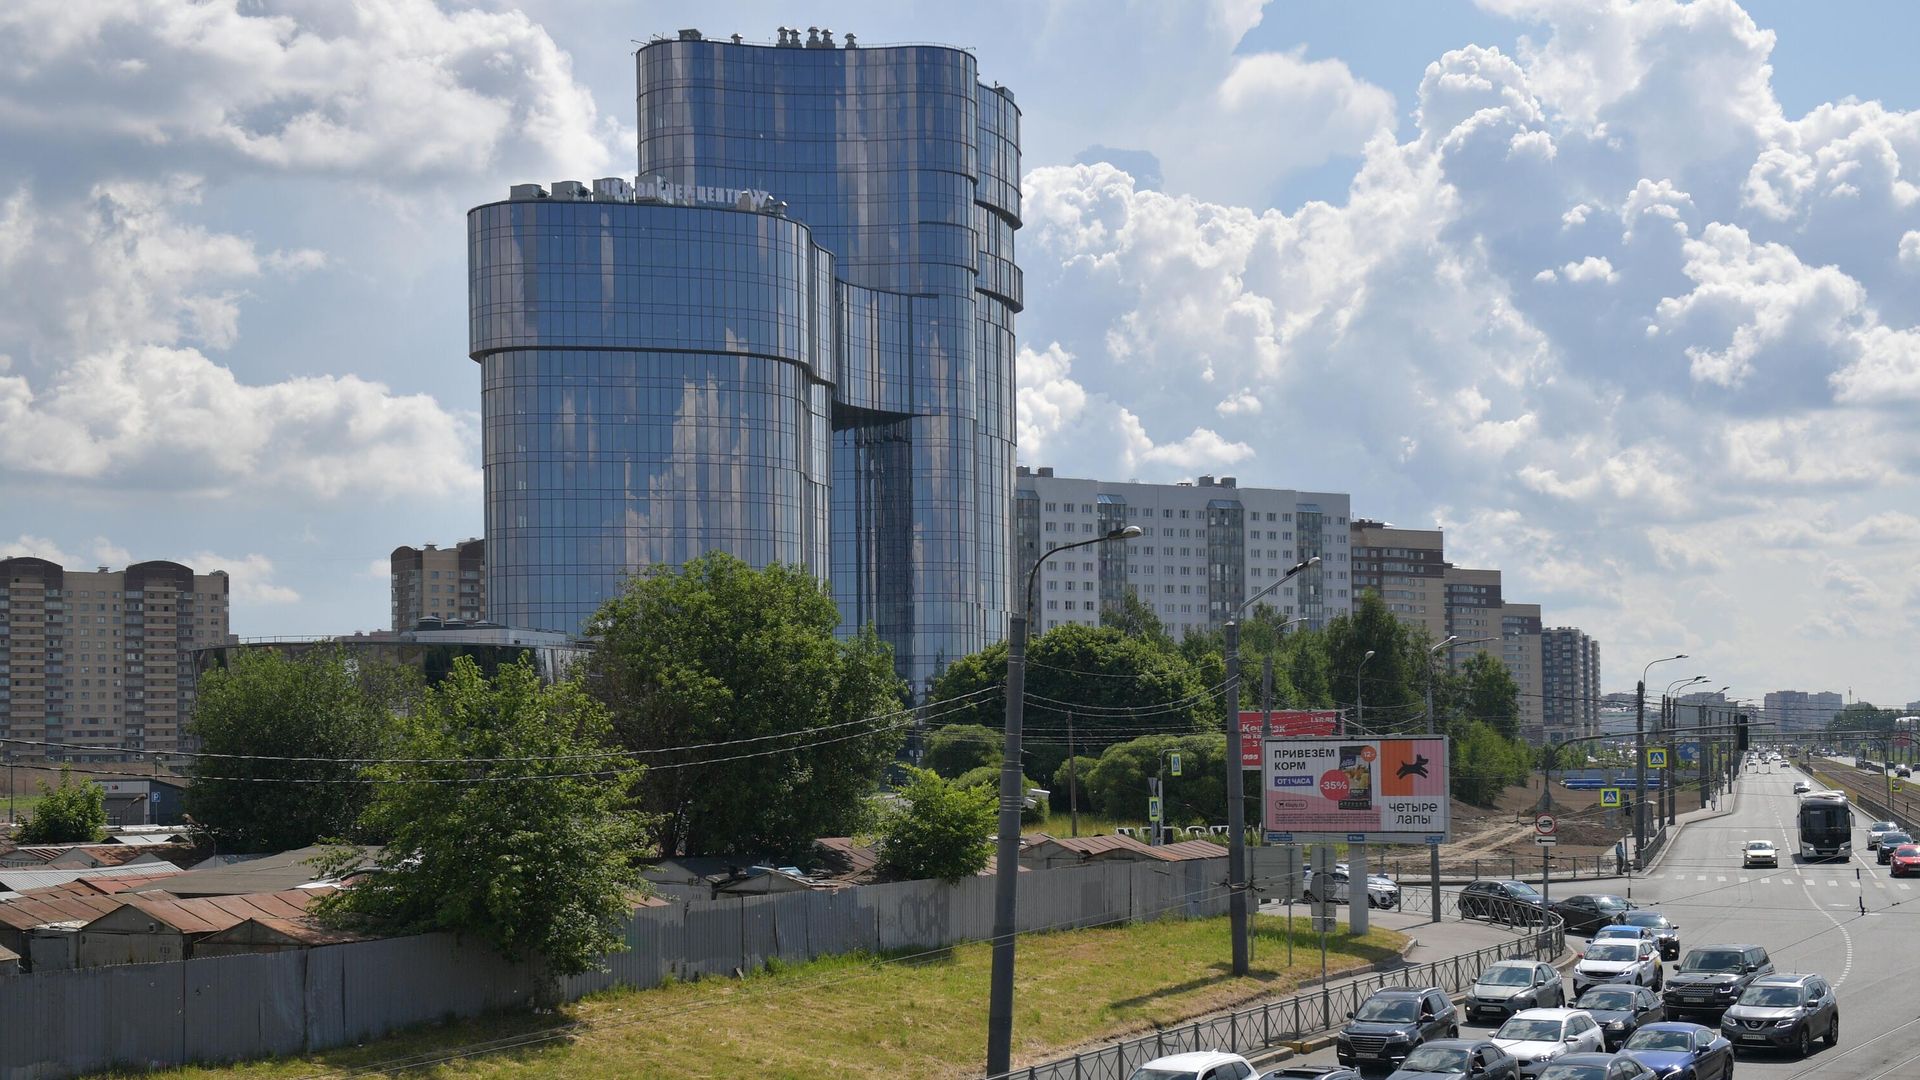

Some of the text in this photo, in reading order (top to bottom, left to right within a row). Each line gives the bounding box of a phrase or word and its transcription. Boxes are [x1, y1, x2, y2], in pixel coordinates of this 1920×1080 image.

[696, 186, 743, 205] ЦЕНТР
[1274, 761, 1306, 771] КОРМ
[1277, 777, 1287, 785] ОТ
[1292, 777, 1311, 785] ЧАСА
[1320, 781, 1348, 790] -35%
[1389, 802, 1438, 813] четыре
[1396, 814, 1431, 825] лапы
